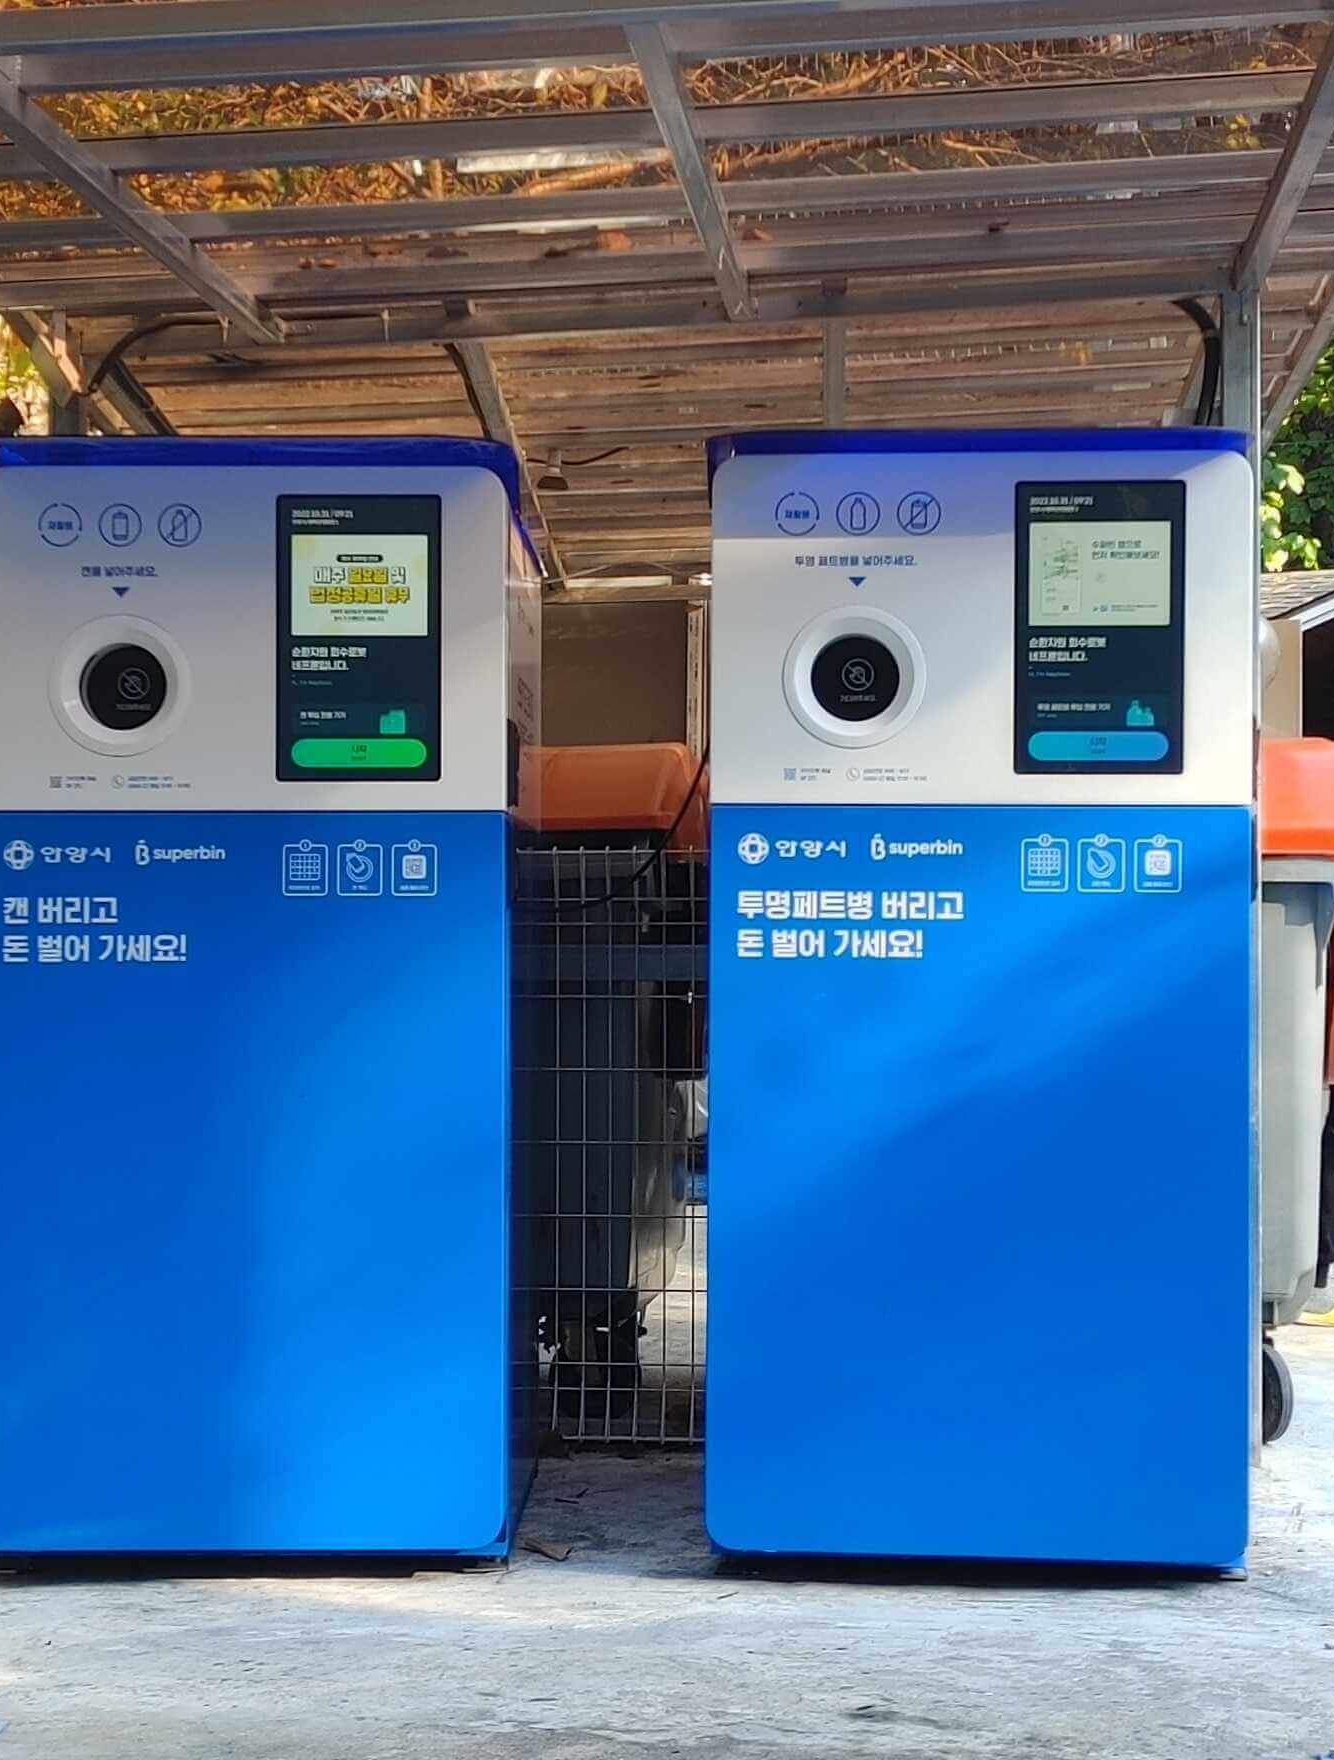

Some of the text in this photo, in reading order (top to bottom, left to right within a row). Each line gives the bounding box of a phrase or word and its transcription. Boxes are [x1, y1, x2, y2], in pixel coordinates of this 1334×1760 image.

[795, 555, 815, 567] 투명
[314, 567, 406, 584] 매주 일요일 및
[1029, 637, 1067, 648] 순환자원
[40, 847, 111, 863] 안양시
[153, 845, 226, 863] superbin
[775, 840, 846, 858] 안양시
[889, 839, 964, 858] superbin
[3, 896, 118, 924] 캔 버리고
[737, 890, 964, 920] 투명페트병 버리고
[2, 934, 187, 962] 돈 벌어 가세요!
[737, 929, 923, 958] 돈 벌어 가세요!
